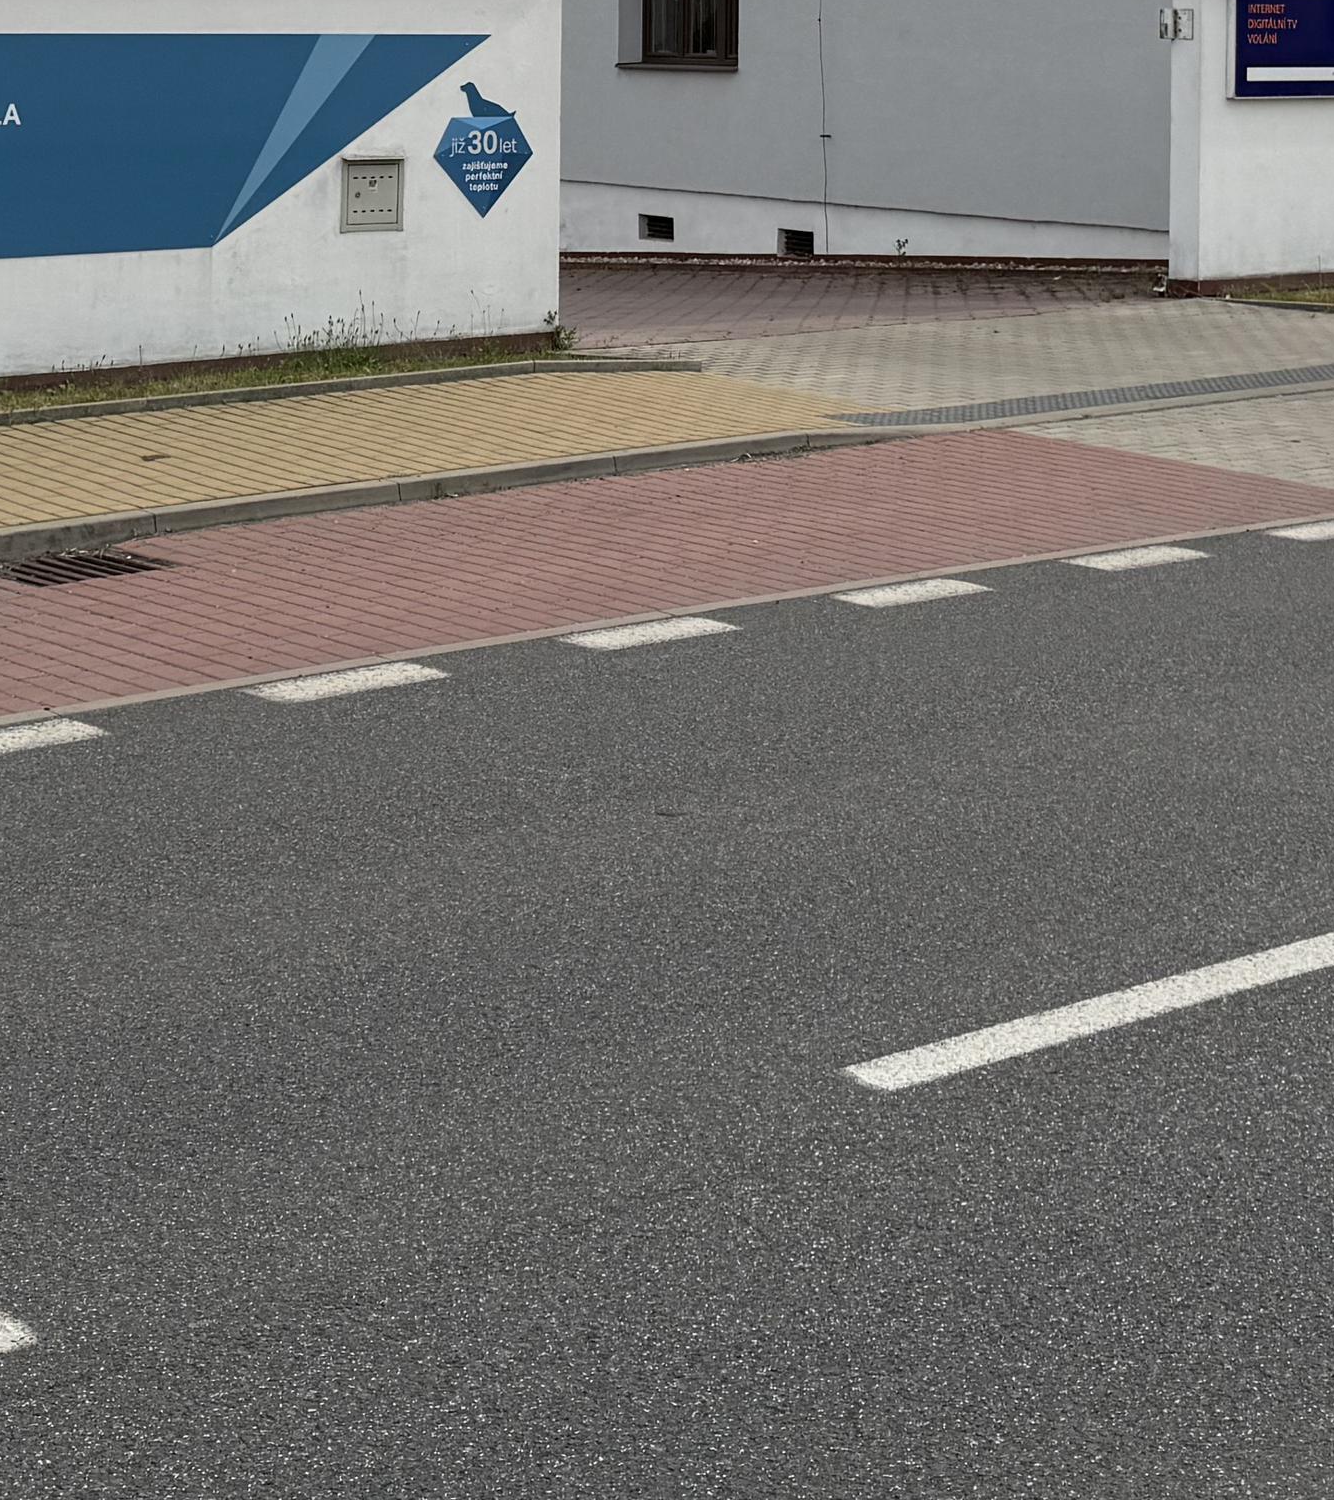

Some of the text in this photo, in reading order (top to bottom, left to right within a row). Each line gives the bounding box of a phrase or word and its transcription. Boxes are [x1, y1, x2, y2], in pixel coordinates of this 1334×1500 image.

[1247, 3, 1285, 14] INTERNET
[1247, 17, 1298, 29] DIGITÁLNÍ TV
[1247, 32, 1278, 44] VOLÁNÍ
[449, 130, 517, 158] již 30 let
[465, 171, 503, 182] perfektní
[469, 181, 499, 192] teplotu
